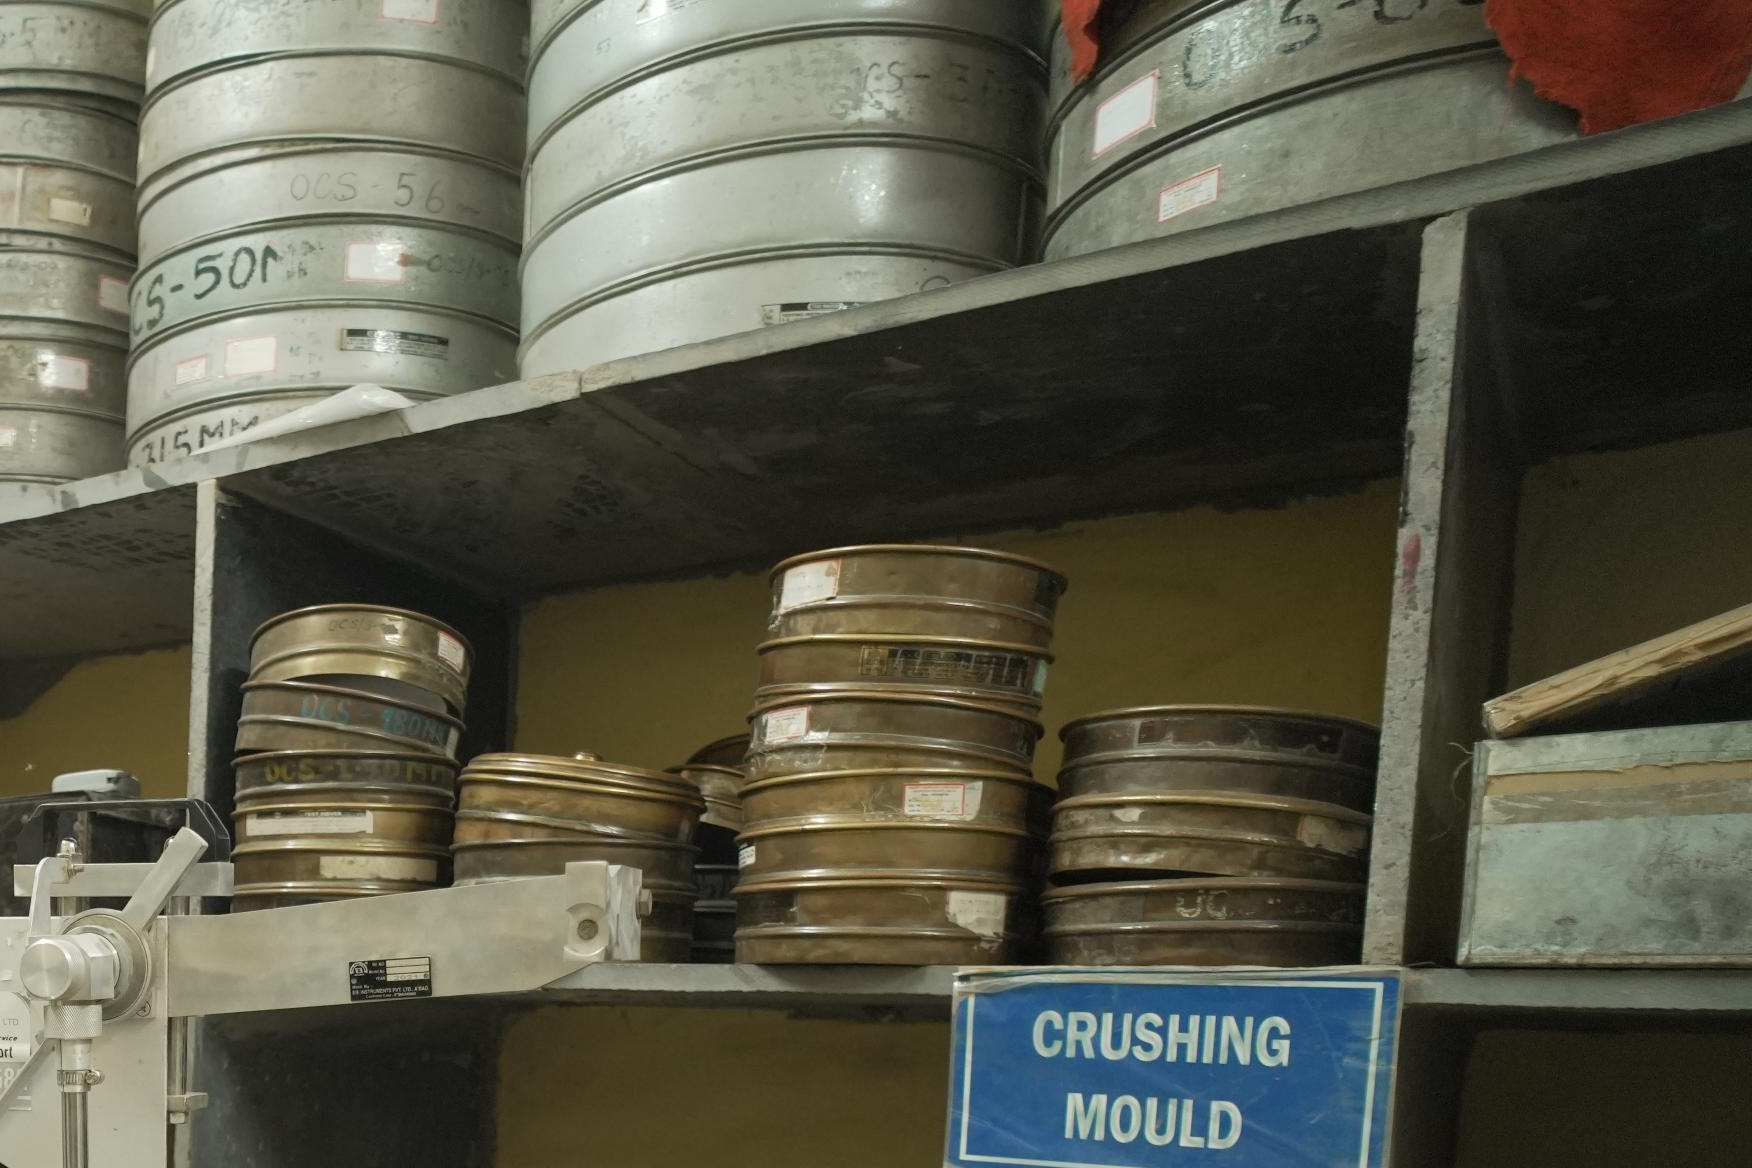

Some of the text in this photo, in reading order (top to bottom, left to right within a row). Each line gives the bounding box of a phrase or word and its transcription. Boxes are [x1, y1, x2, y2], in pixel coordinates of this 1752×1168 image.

[2, 1018, 19, 1026] LTD
[1032, 1009, 1292, 1068] CRUSHING
[1063, 1092, 1243, 1151] MOULD
